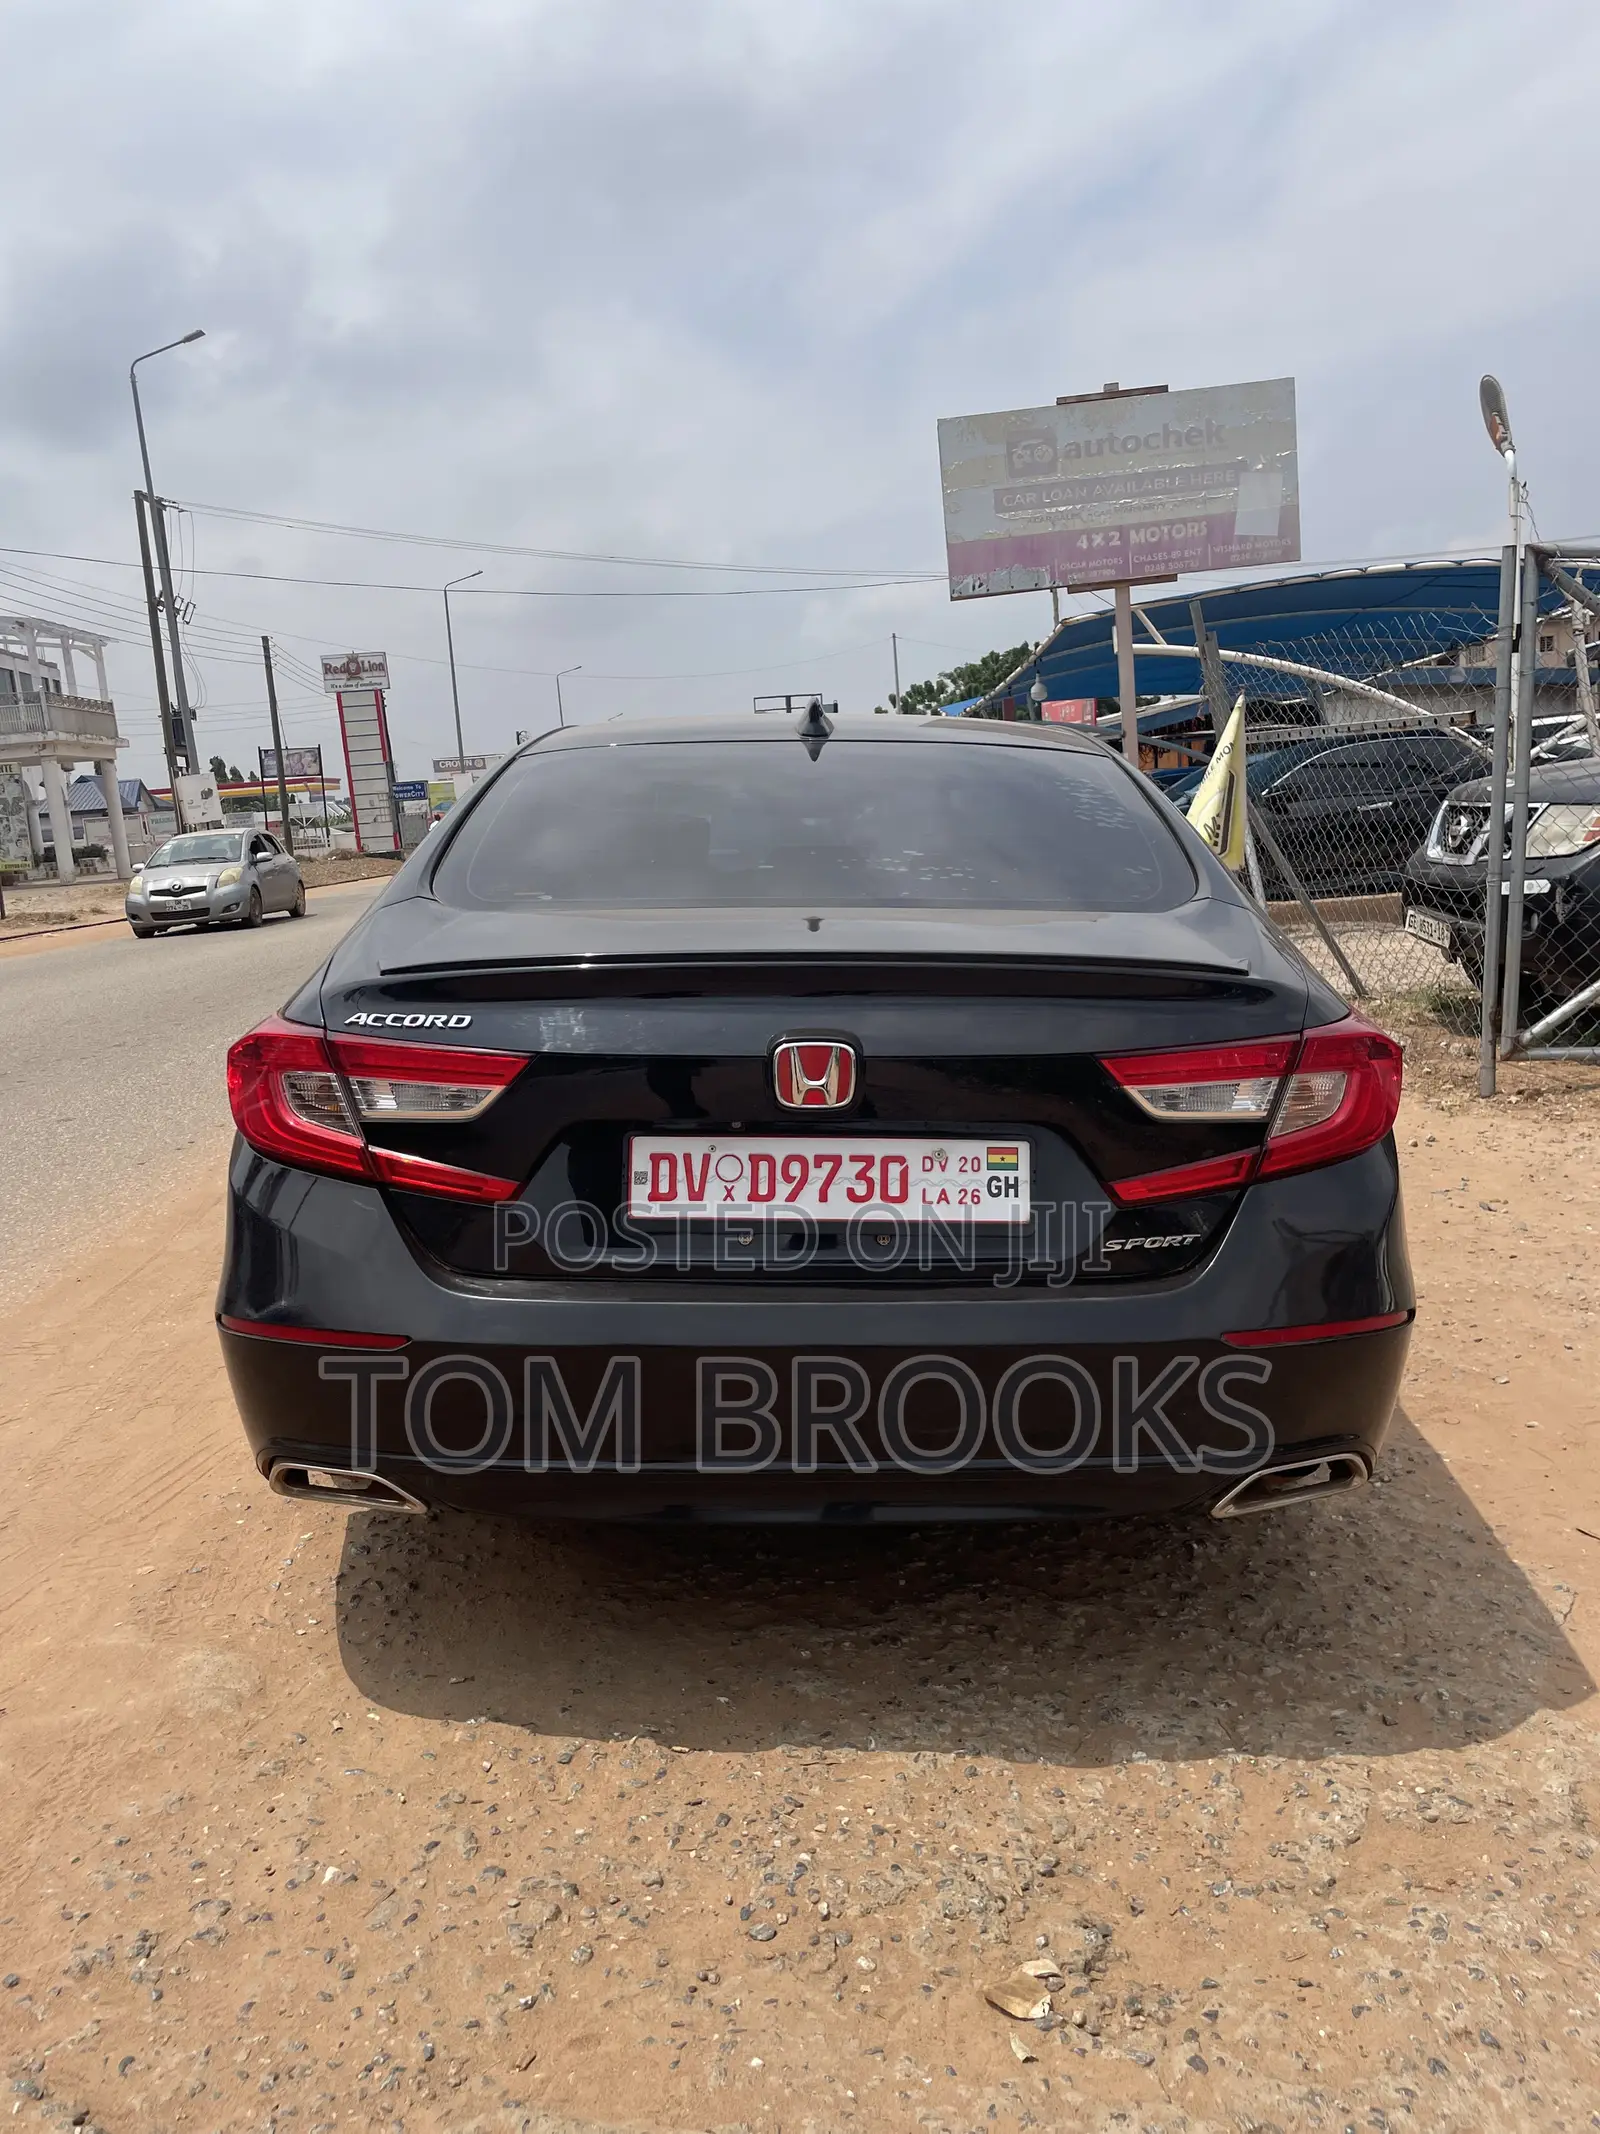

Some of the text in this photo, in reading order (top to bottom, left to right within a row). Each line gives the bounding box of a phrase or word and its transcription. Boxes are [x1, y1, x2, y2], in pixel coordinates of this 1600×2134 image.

[1063, 417, 1228, 459] autochek
[1003, 469, 1236, 507] CAR LOAN AVAILABLE HERE
[1129, 521, 1208, 545] MOTORS
[1089, 556, 1123, 568] MOTORS
[322, 660, 385, 675] Red Lion
[344, 1012, 473, 1029] ACCORD
[922, 1156, 981, 1173] DV 20
[648, 1153, 711, 1202] DV
[747, 1153, 909, 1204] D9730
[986, 1175, 1019, 1199] GH
[922, 1187, 981, 1205] LA 26
[1100, 1234, 1201, 1252] SPORT
